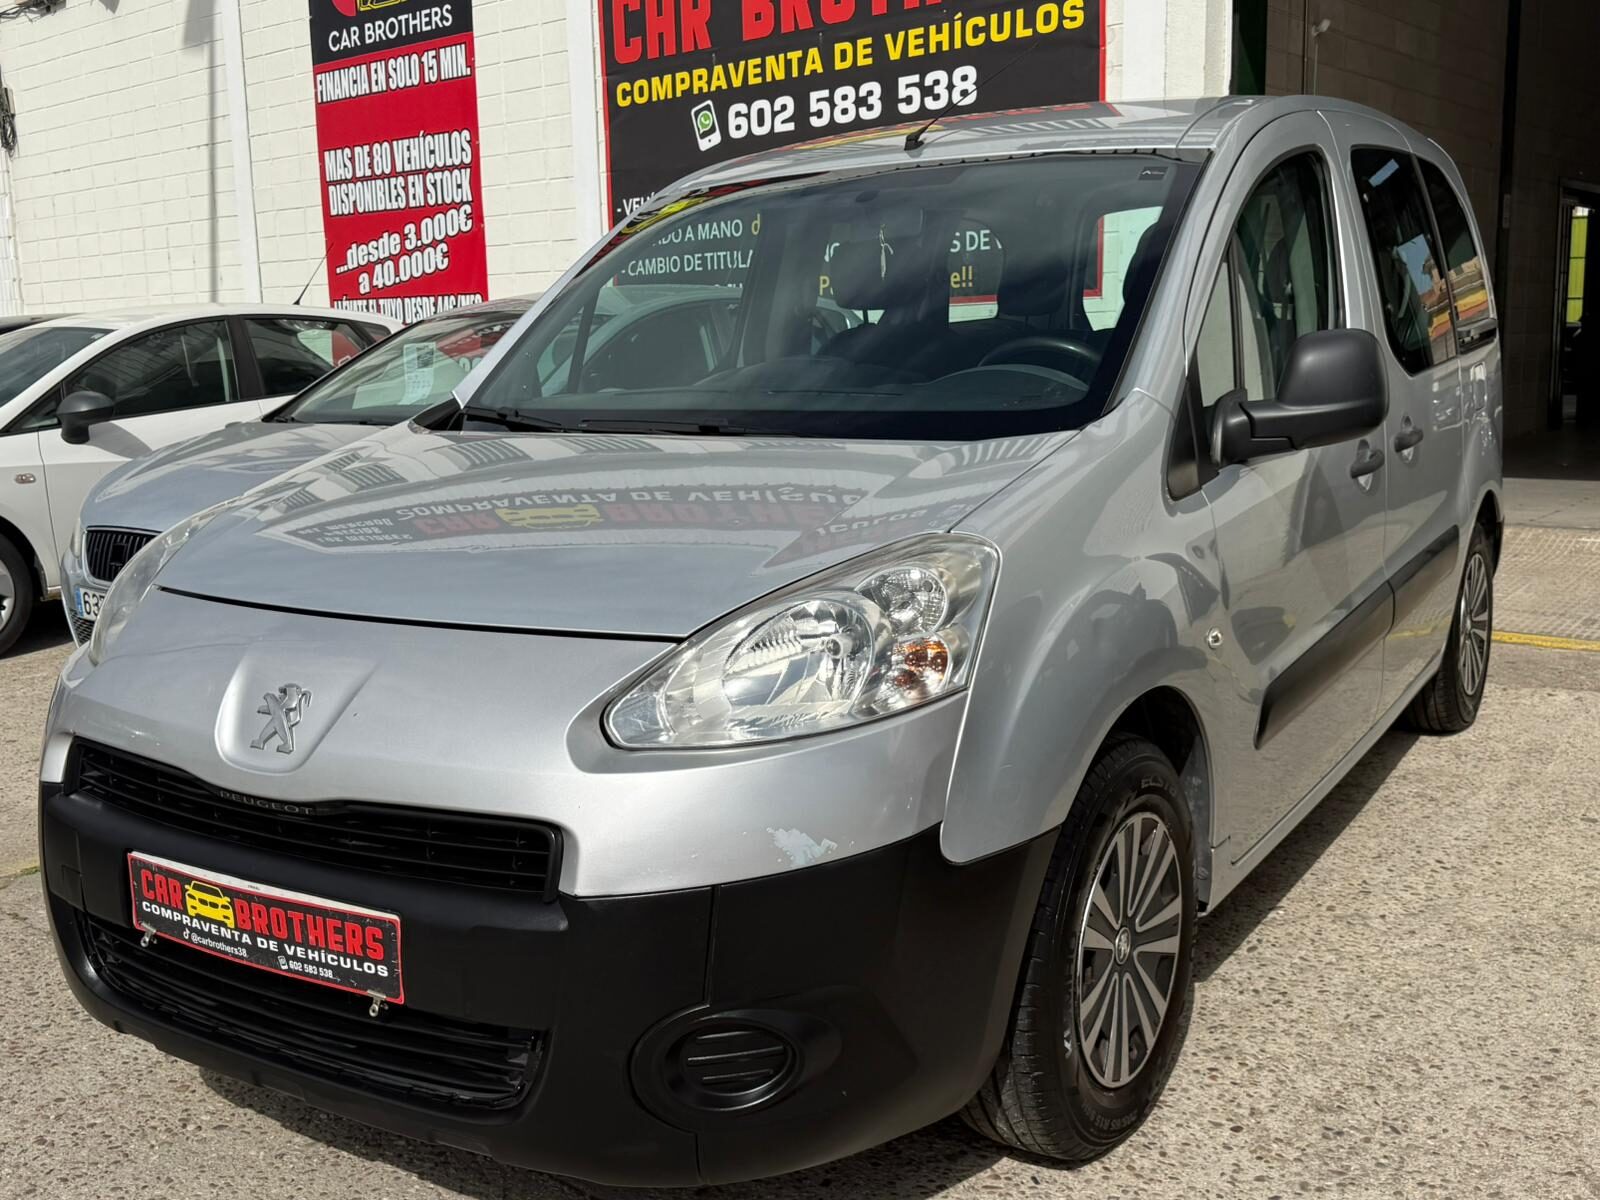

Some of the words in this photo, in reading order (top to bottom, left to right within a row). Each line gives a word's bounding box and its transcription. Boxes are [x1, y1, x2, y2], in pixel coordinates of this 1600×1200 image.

[328, 26, 362, 52] CAR
[364, 4, 453, 44] BROTHERS
[612, 0, 713, 64] CAR
[316, 64, 370, 104] FINANCIA
[370, 60, 387, 93] EN
[388, 53, 420, 90] SOLO
[421, 49, 438, 83] 15
[439, 43, 472, 80] MIN.
[616, 47, 824, 108] COMPRAVENTA
[834, 37, 873, 71] DE
[885, 0, 1085, 61] VEHÍCULOS
[728, 95, 796, 139] 602
[809, 81, 882, 128] 583
[897, 65, 978, 114] 538
[324, 147, 353, 182] MAS
[354, 144, 372, 177] DE
[372, 141, 392, 176] 80
[392, 130, 473, 173] VEHÍCULOS
[328, 175, 407, 216] DISPONIBLES
[407, 174, 425, 208] EN
[426, 168, 473, 206] STOCK
[336, 232, 401, 274] ...desde
[404, 204, 473, 250] 3.000€
[698, 219, 743, 241] MANO
[966, 229, 990, 251] DE
[359, 272, 370, 294] a
[373, 243, 449, 289] 40.000€
[628, 255, 680, 276] CAMBIO
[684, 254, 703, 272] DE
[141, 869, 184, 911] CAR
[233, 898, 385, 961] BROTHERS
[142, 901, 252, 945] COMPRAVENTA
[256, 937, 279, 952] DE
[284, 943, 389, 977] VEHÍCULOS
[191, 932, 247, 958] @carbrothers38
[288, 960, 303, 972] 602
[304, 965, 318, 975] 583
[319, 969, 333, 979] 538
